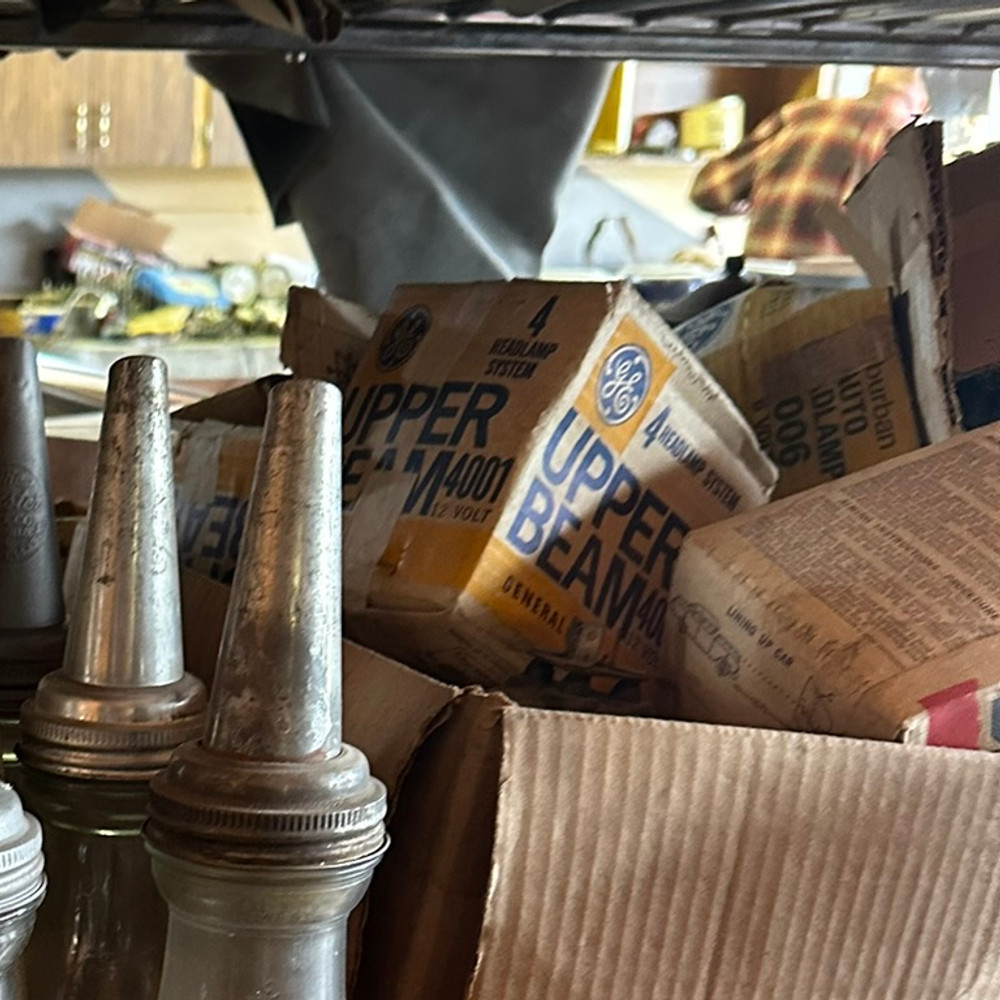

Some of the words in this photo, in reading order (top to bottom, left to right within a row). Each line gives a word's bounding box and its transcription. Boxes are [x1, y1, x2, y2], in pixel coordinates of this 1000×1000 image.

[528, 294, 560, 338] 4
[484, 358, 539, 379] SYSTEM
[487, 336, 560, 361] HEADLAMP
[341, 380, 511, 449] UPPER
[597, 343, 652, 427] GE
[643, 405, 672, 450] 4
[658, 425, 706, 477] HEADLAMP
[702, 468, 742, 512] SYSTEM
[811, 386, 846, 478] DLAMP
[443, 452, 517, 504] 4001
[542, 406, 692, 590] UPPER
[453, 504, 493, 524] VOLT
[506, 477, 649, 641] BEAM
[637, 588, 668, 648] 40
[502, 574, 567, 635] GENERAL
[726, 604, 758, 637] LINING
[758, 633, 775, 648] UP
